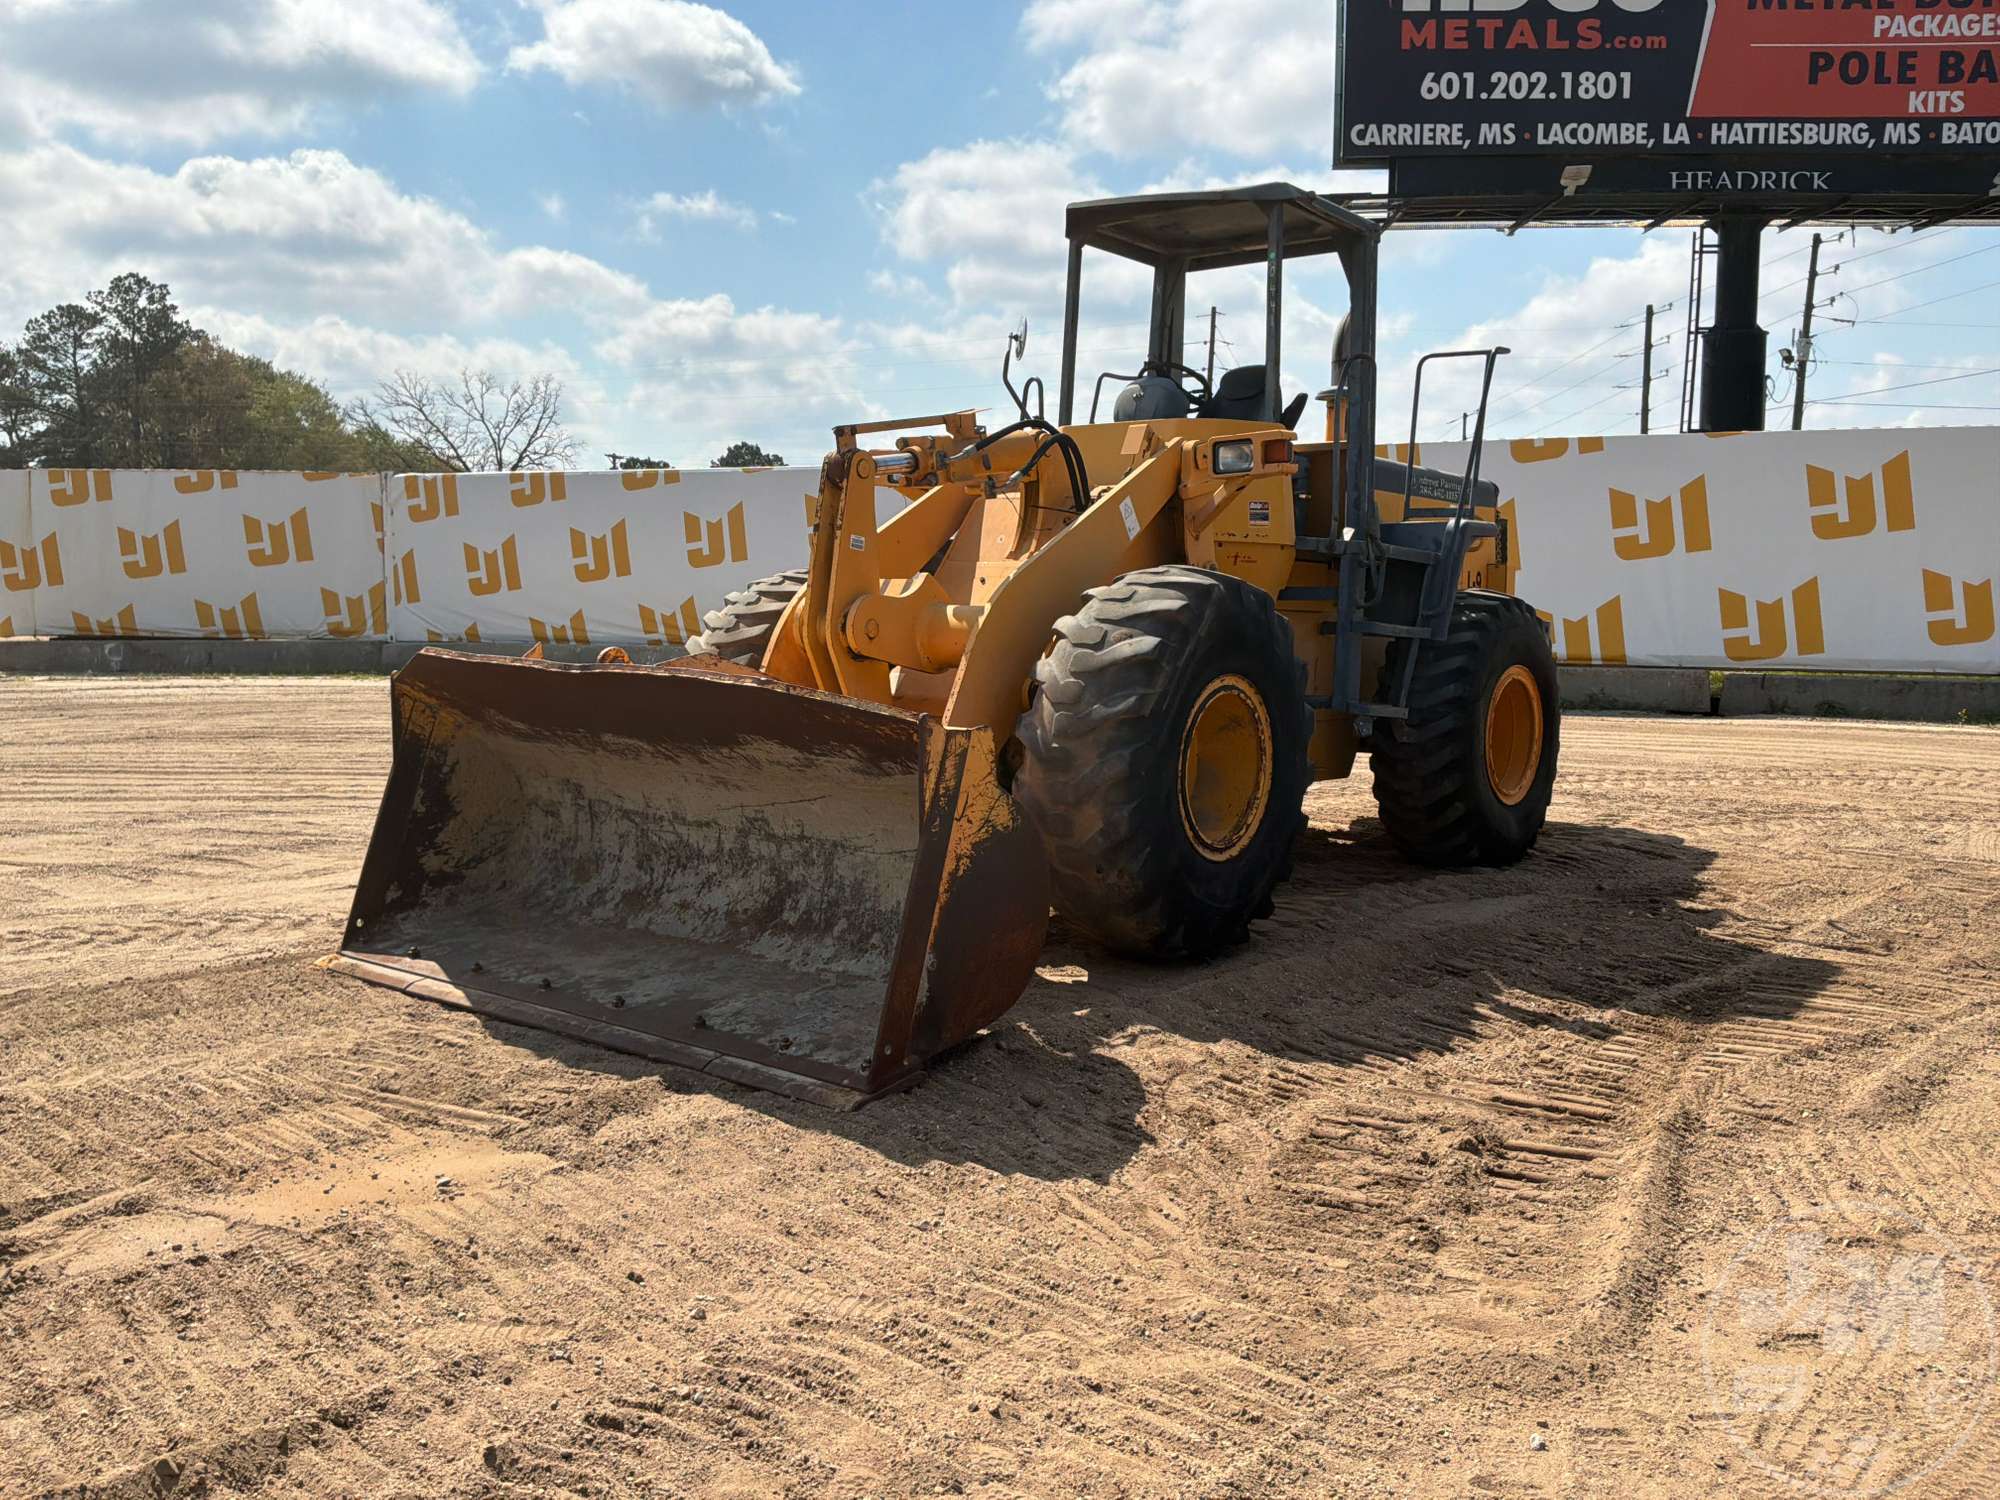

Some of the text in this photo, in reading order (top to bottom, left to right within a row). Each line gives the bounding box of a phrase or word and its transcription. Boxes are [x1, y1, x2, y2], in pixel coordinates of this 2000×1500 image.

[1873, 13, 2000, 37] PACKAGE
[1808, 50, 1918, 85] POLE
[1420, 71, 1632, 100] 601.202.1801
[1908, 90, 1965, 113] KITS
[1350, 123, 1471, 149] CARRIERE,
[1478, 124, 1516, 145] MS
[1537, 123, 1655, 148] LACOMBE,
[1663, 123, 1691, 145] LA
[1710, 122, 1876, 149] HATTIESBURG,
[1883, 122, 1921, 145] MS
[1670, 171, 1832, 190] HEADRICK
